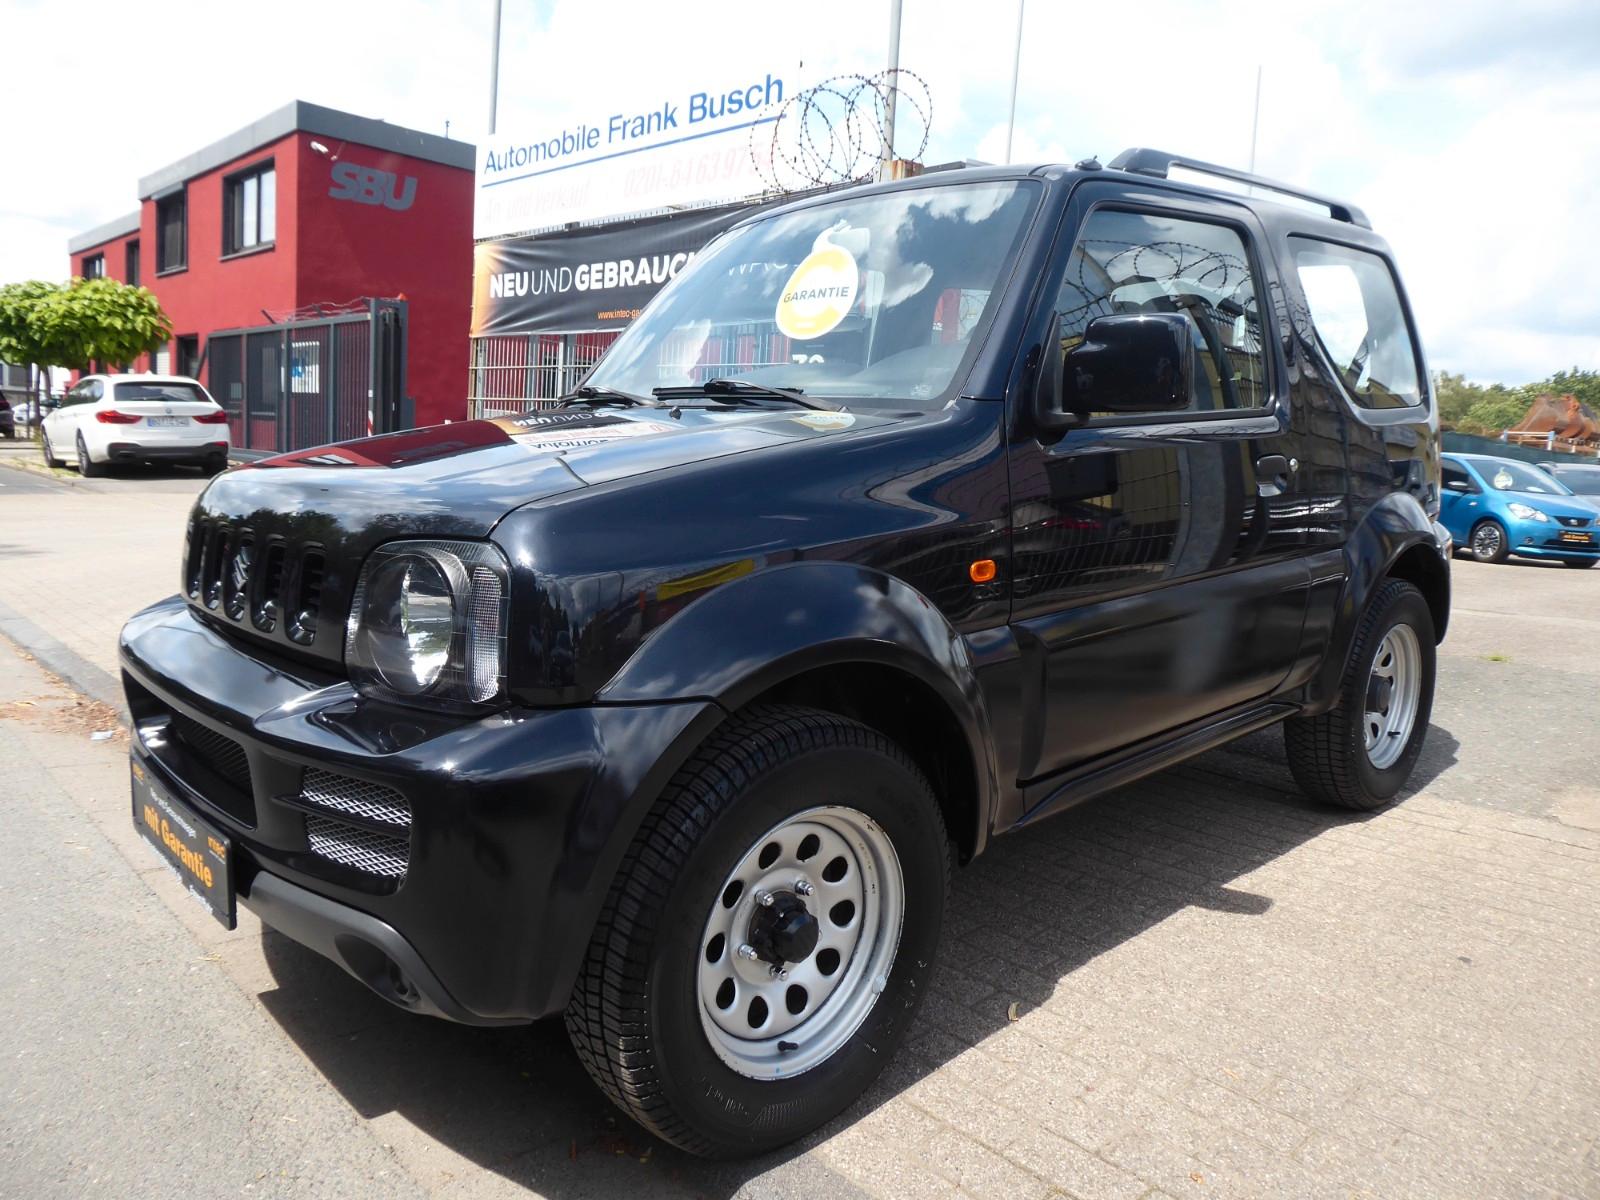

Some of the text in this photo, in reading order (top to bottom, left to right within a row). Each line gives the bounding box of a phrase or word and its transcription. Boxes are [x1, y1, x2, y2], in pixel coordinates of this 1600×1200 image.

[484, 73, 783, 174] Automobile Frank Busch
[328, 162, 418, 211] SBU
[597, 308, 641, 320] www.intec-ga
[783, 286, 850, 303] GARANTIE
[142, 803, 161, 837] mit
[160, 818, 215, 889] Garantie
